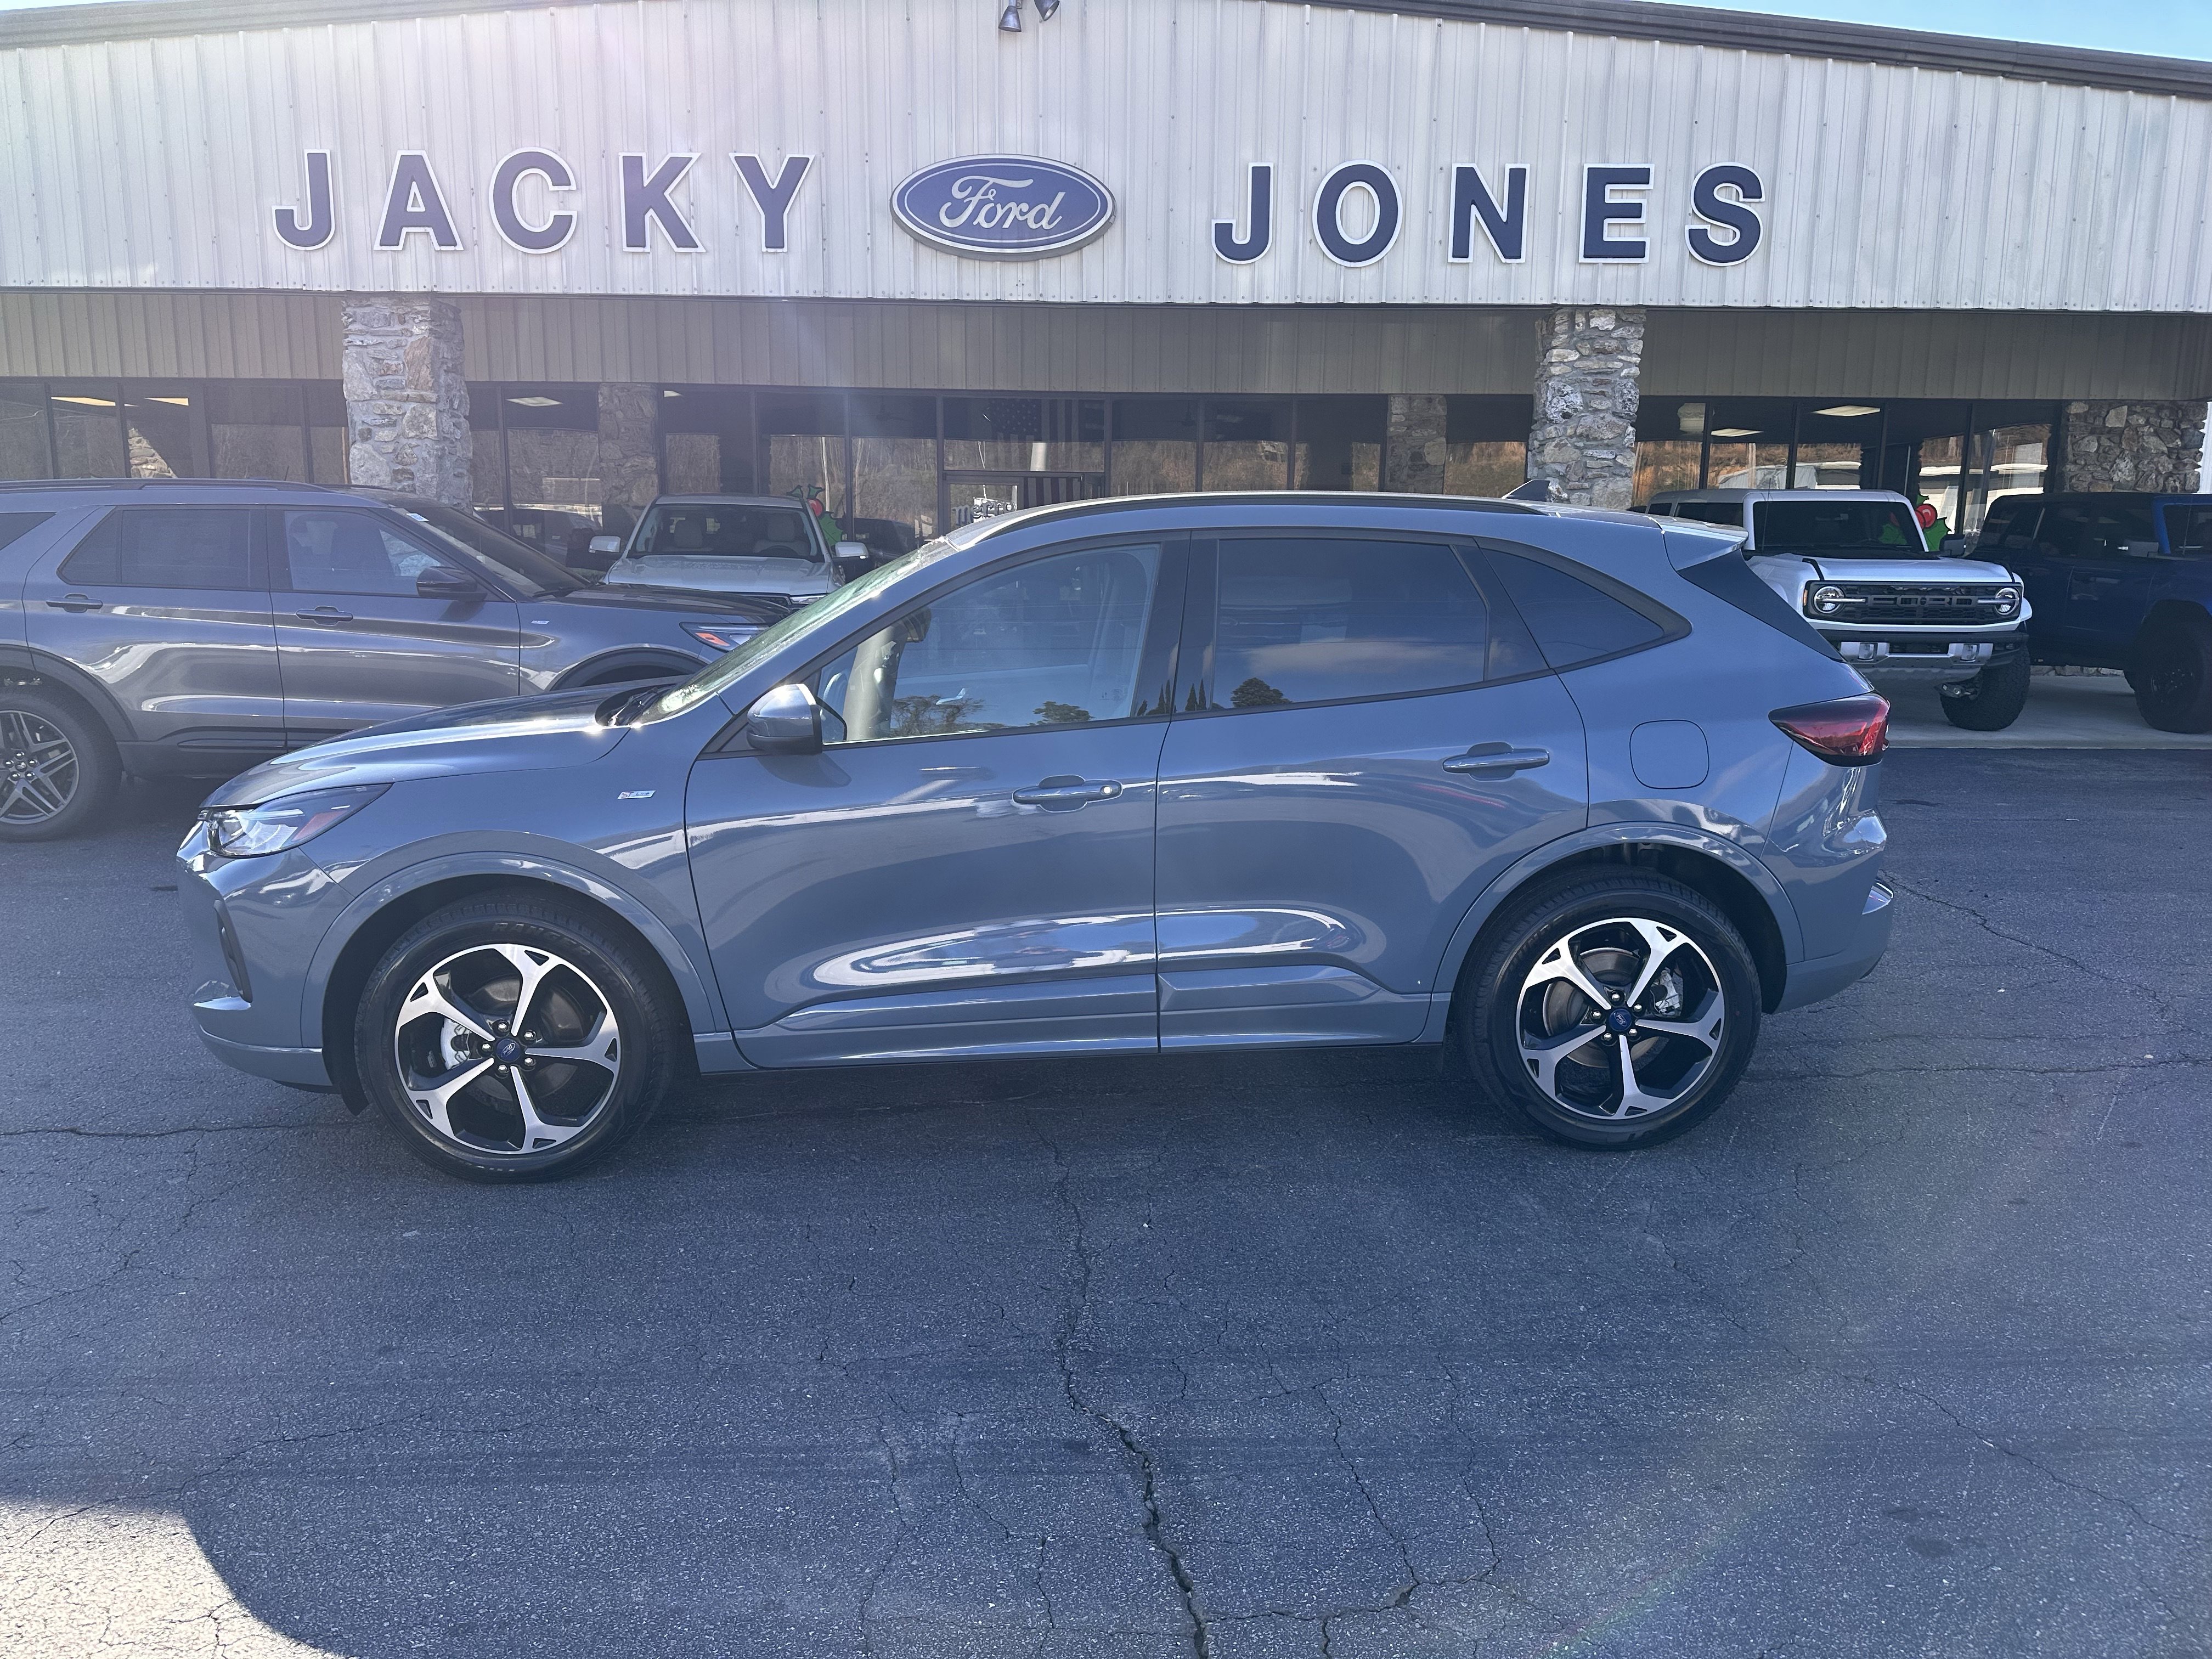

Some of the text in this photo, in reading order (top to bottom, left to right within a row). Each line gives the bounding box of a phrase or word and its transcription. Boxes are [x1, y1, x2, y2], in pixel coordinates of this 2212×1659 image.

[273, 147, 1765, 268] JACKY Ford JONES
[1867, 594, 1976, 608] FORD
